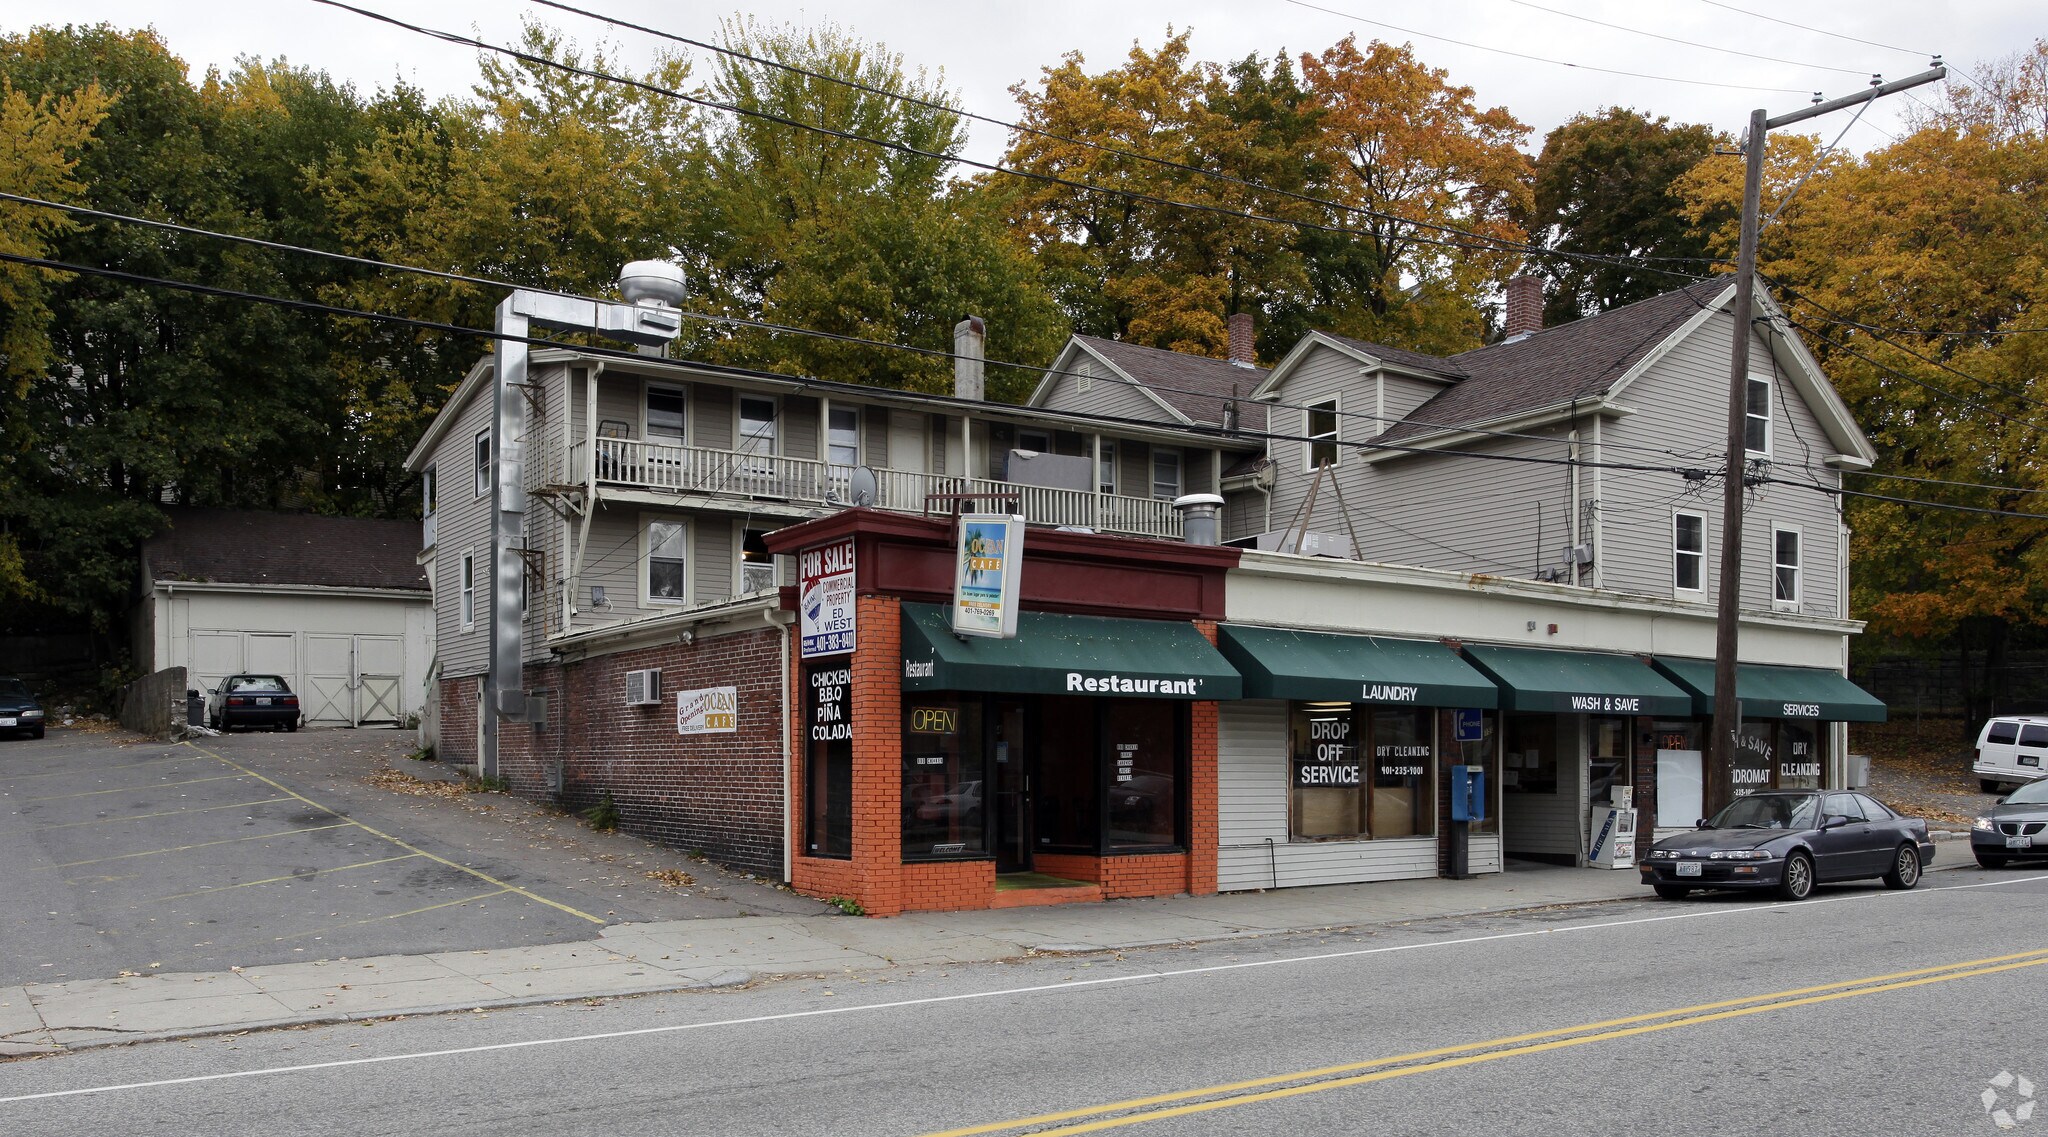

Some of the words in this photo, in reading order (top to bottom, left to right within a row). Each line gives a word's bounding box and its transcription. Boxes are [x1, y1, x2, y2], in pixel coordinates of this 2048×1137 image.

[802, 551, 821, 579] FOR
[825, 543, 852, 574] SALE
[823, 577, 853, 593] COMMERCIAL
[827, 590, 851, 606] PROPERTY
[832, 607, 844, 619] ED
[824, 617, 852, 631] WEST
[812, 669, 850, 687] CHICKEN
[704, 691, 735, 711] OCEAN
[1362, 684, 1418, 701] LAUNDRY
[679, 693, 704, 716] Grand
[1571, 696, 1601, 710] WASH
[1604, 697, 1611, 711] &
[1614, 698, 1639, 712] SAVE
[1783, 703, 1820, 717] SERVICES
[913, 709, 956, 731] OPEN
[812, 723, 852, 741] COLADA
[1311, 722, 1350, 740] DROP
[1663, 734, 1687, 750] OPEN
[1740, 735, 1746, 747] &
[1748, 735, 1773, 761] SAVE
[1793, 742, 1808, 755] DRY
[1317, 744, 1344, 761] OFF
[1376, 746, 1390, 757] DRY
[1394, 746, 1430, 757] CLEANING
[1301, 766, 1359, 783] SERVICE
[1781, 763, 1821, 776] CLEANING
